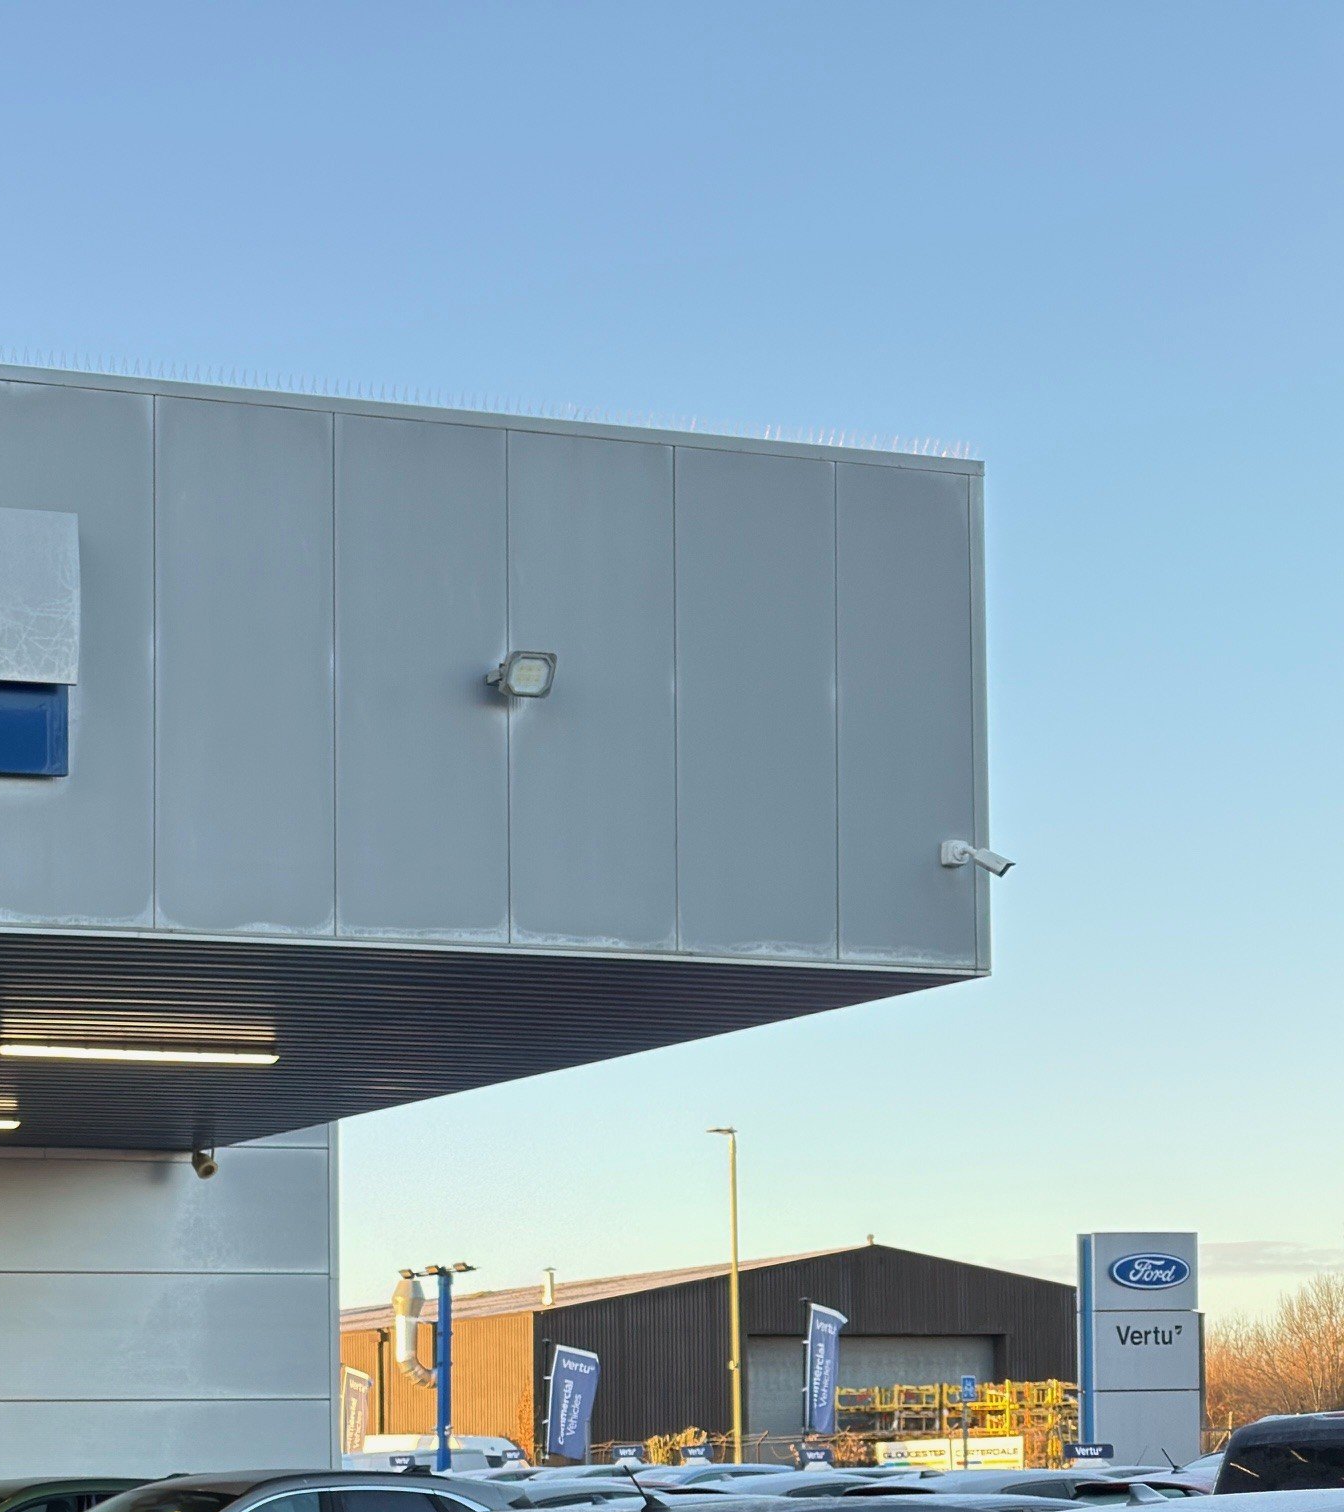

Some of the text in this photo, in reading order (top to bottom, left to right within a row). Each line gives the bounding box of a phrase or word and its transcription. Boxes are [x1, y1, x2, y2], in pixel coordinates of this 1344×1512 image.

[1129, 1259, 1176, 1282] Ford
[1116, 1325, 1173, 1346] Vertu
[562, 1359, 591, 1375] Vertu
[558, 1379, 574, 1446] Commercial
[566, 1393, 582, 1437] Vehicles
[883, 1449, 946, 1459] GLOUCESTER
[1075, 1446, 1096, 1457] Vertu
